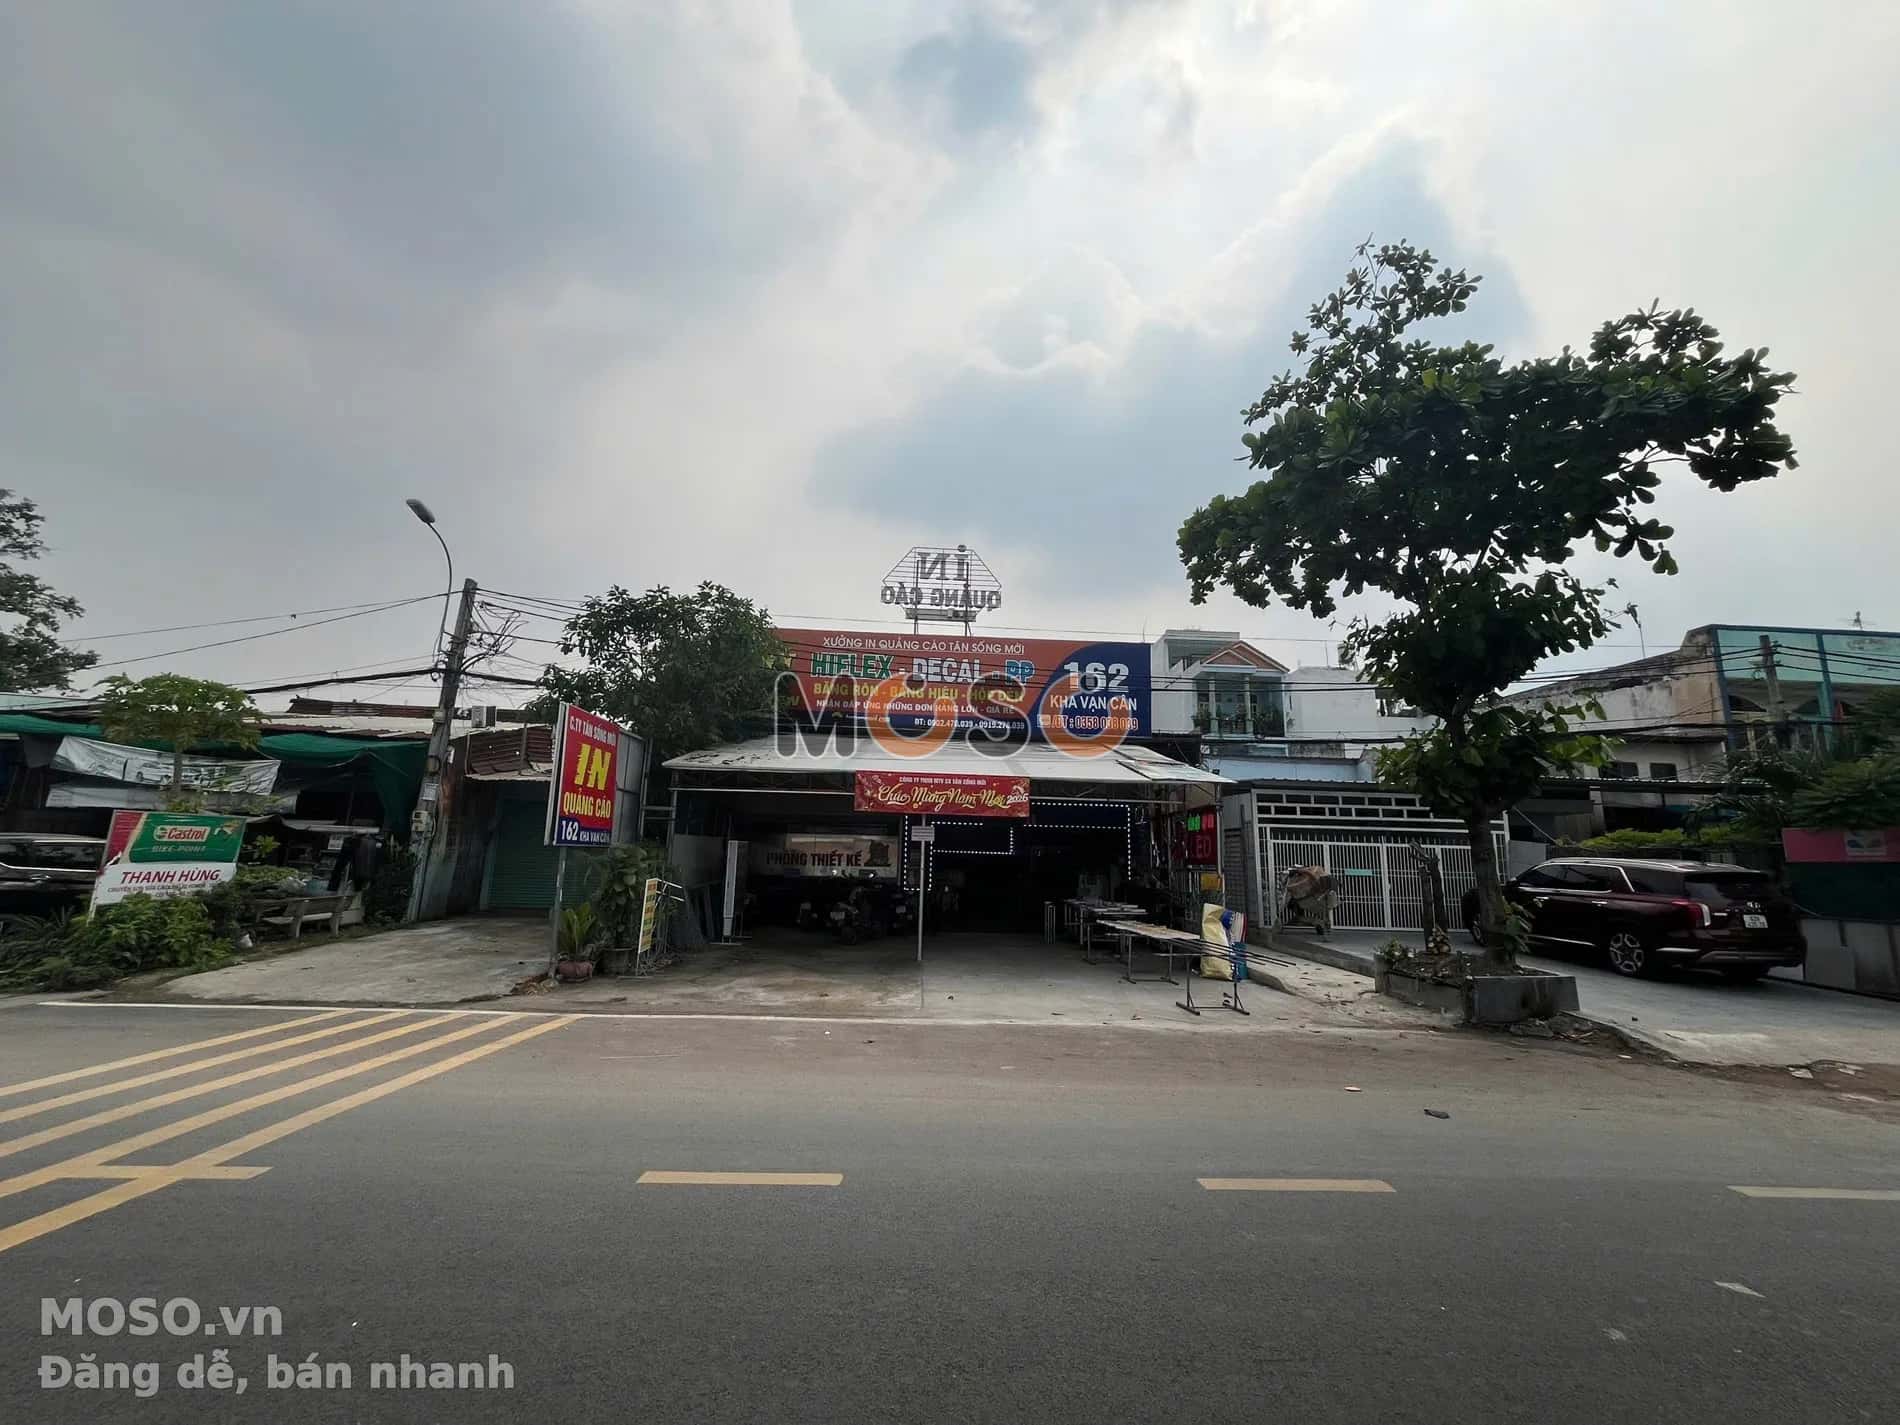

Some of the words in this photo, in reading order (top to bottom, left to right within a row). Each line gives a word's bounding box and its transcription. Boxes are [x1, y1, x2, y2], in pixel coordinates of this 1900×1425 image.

[823, 634, 863, 648] XƯỞNG
[865, 639, 876, 649] IN
[879, 637, 920, 650] QUẢNG
[925, 640, 947, 651] CÁO
[949, 640, 969, 652] TÂN
[971, 641, 1002, 654] SỐNG
[1004, 644, 1025, 655] MỚI
[811, 652, 895, 679] HIFLEX
[912, 657, 986, 684] DECAL
[1004, 659, 1036, 686] PP
[1063, 661, 1130, 693] 162
[1050, 695, 1078, 710] KHA
[1080, 696, 1107, 713] VẠN
[1109, 695, 1137, 711] CÂN
[1074, 715, 1100, 730] 0358
[574, 743, 612, 791] IN
[563, 788, 595, 818] QUẢNG
[595, 795, 612, 819] CÁO
[167, 827, 206, 840] Castrol
[561, 820, 579, 841] 162
[810, 849, 844, 867] THIẾT
[120, 870, 177, 884] THANH
[177, 866, 222, 882] HÙNG
